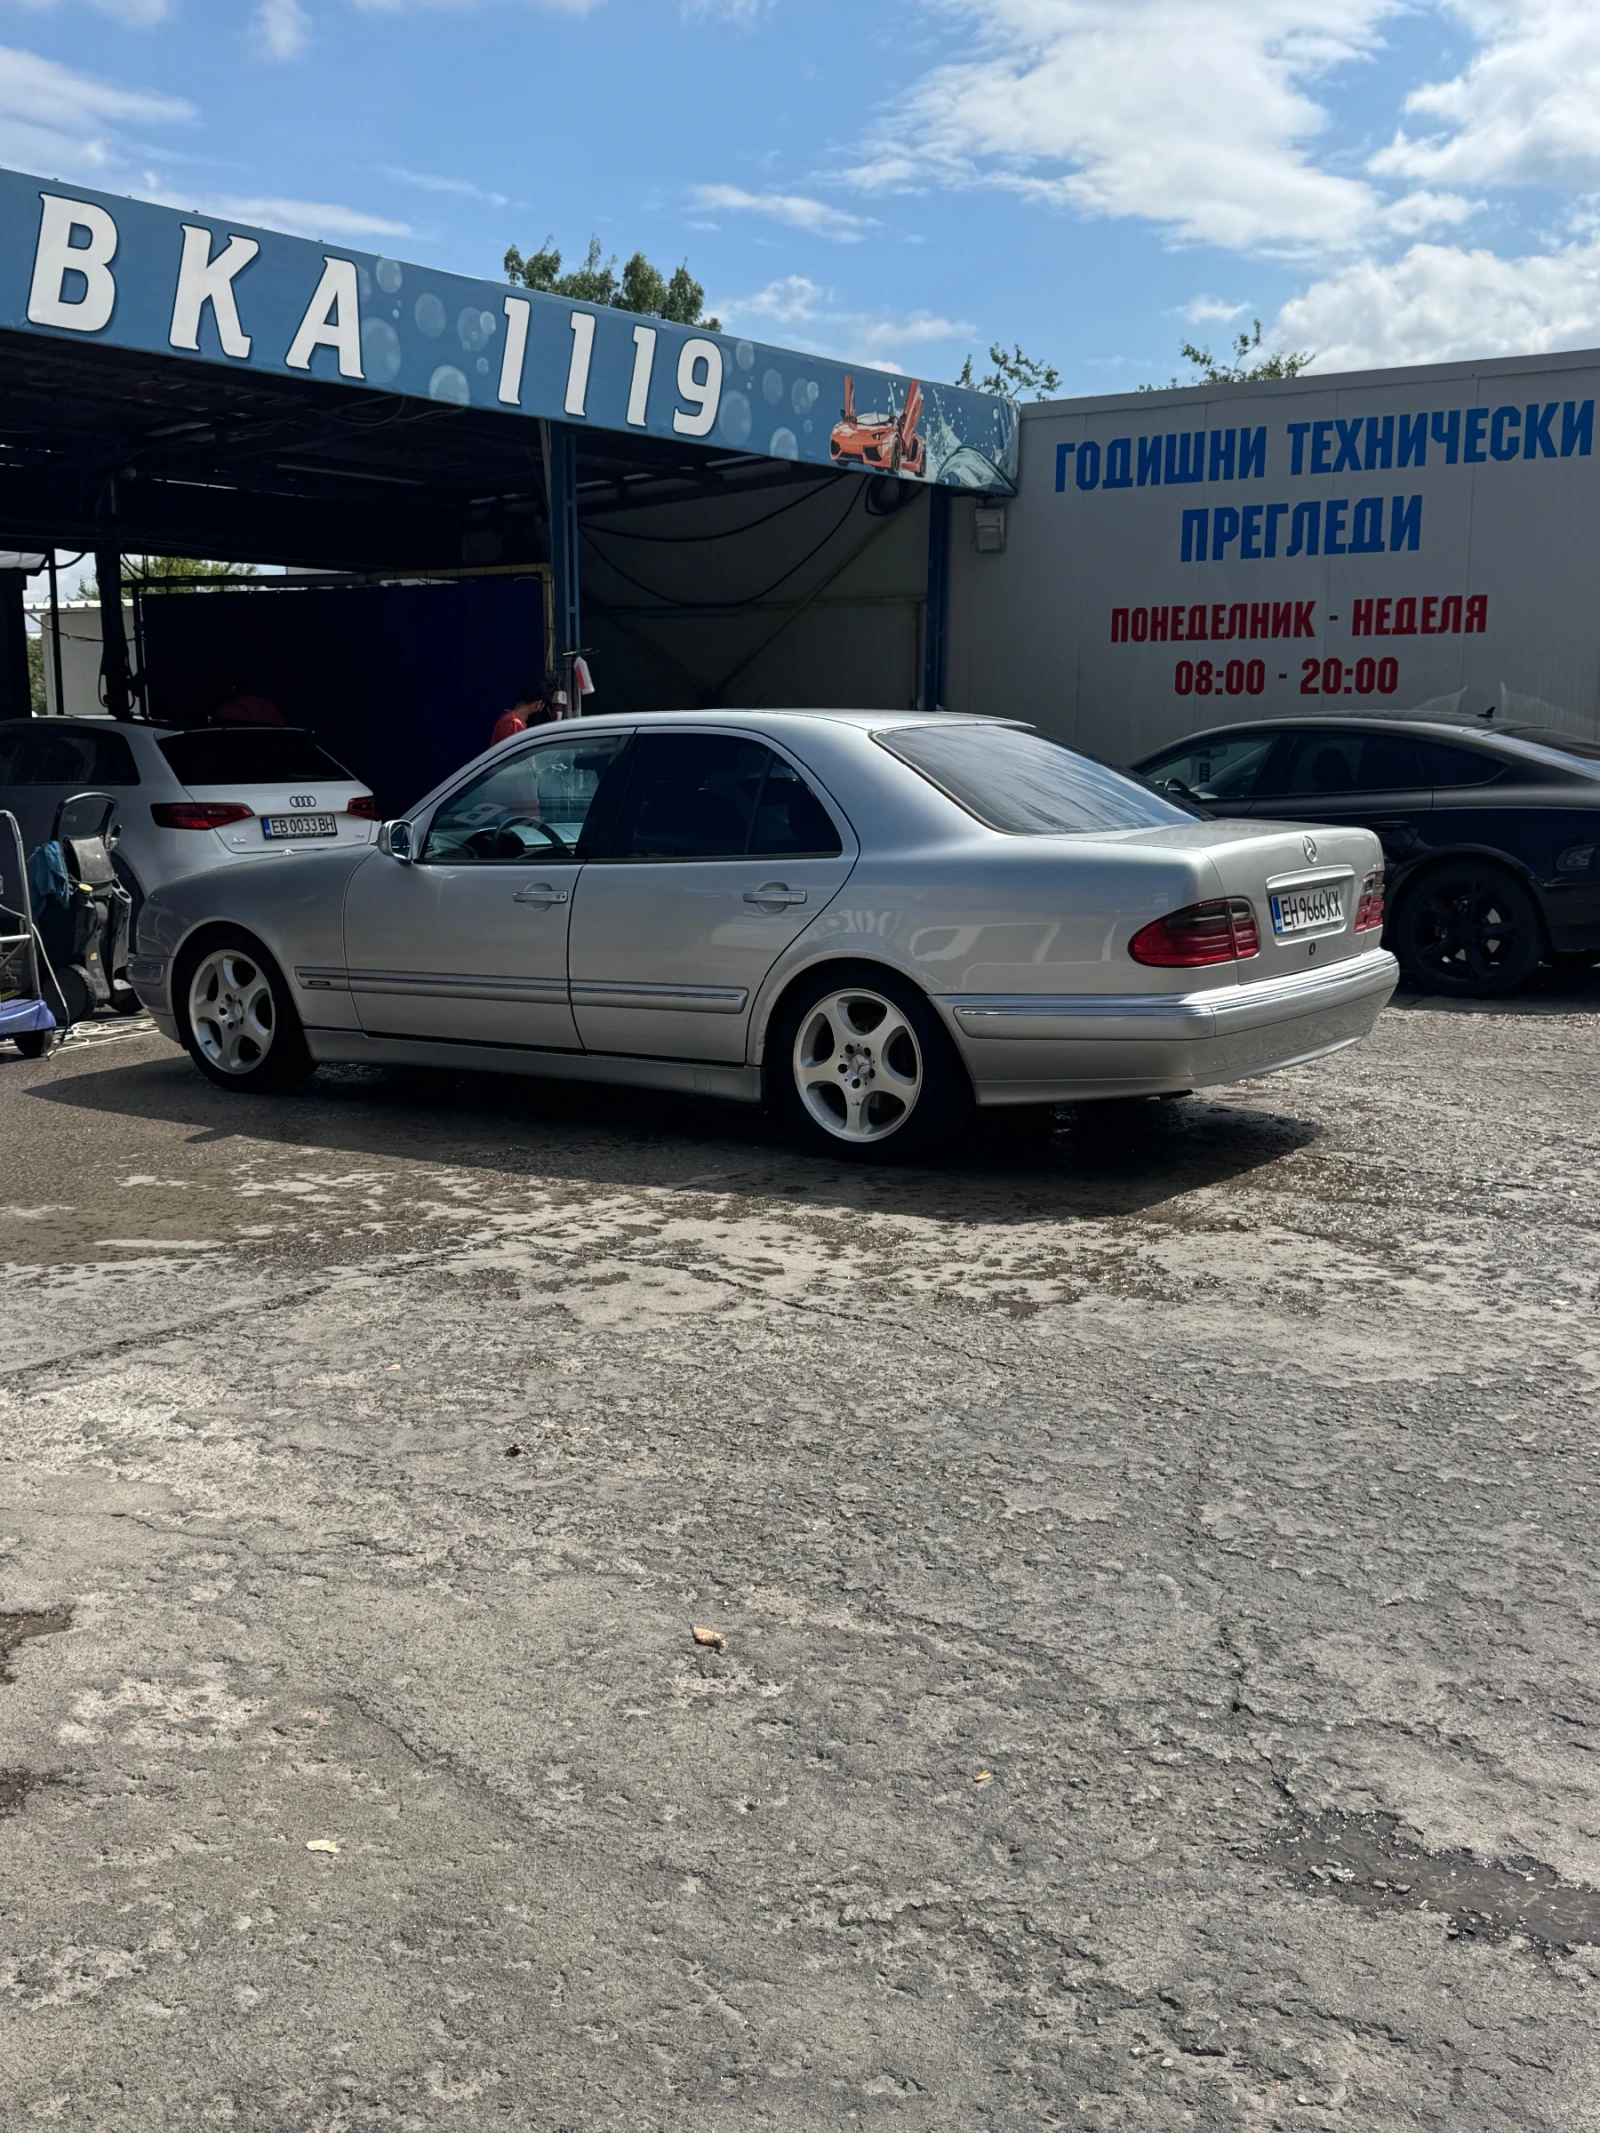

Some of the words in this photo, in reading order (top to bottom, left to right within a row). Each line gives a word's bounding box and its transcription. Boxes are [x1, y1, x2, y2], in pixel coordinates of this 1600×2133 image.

[498, 296, 724, 437] 1119
[1054, 426, 1267, 493] ГОДИШНИ
[1286, 399, 1595, 476] ТЕХНИЧЕСКИ
[1180, 495, 1423, 563] ПРЕГЛЕДИ
[1110, 600, 1316, 643] ПОНЕДЕЛНИК
[1351, 593, 1489, 636] НЕДЕЛЯ
[1174, 659, 1266, 696] 08:00
[1299, 656, 1399, 695] 20:00
